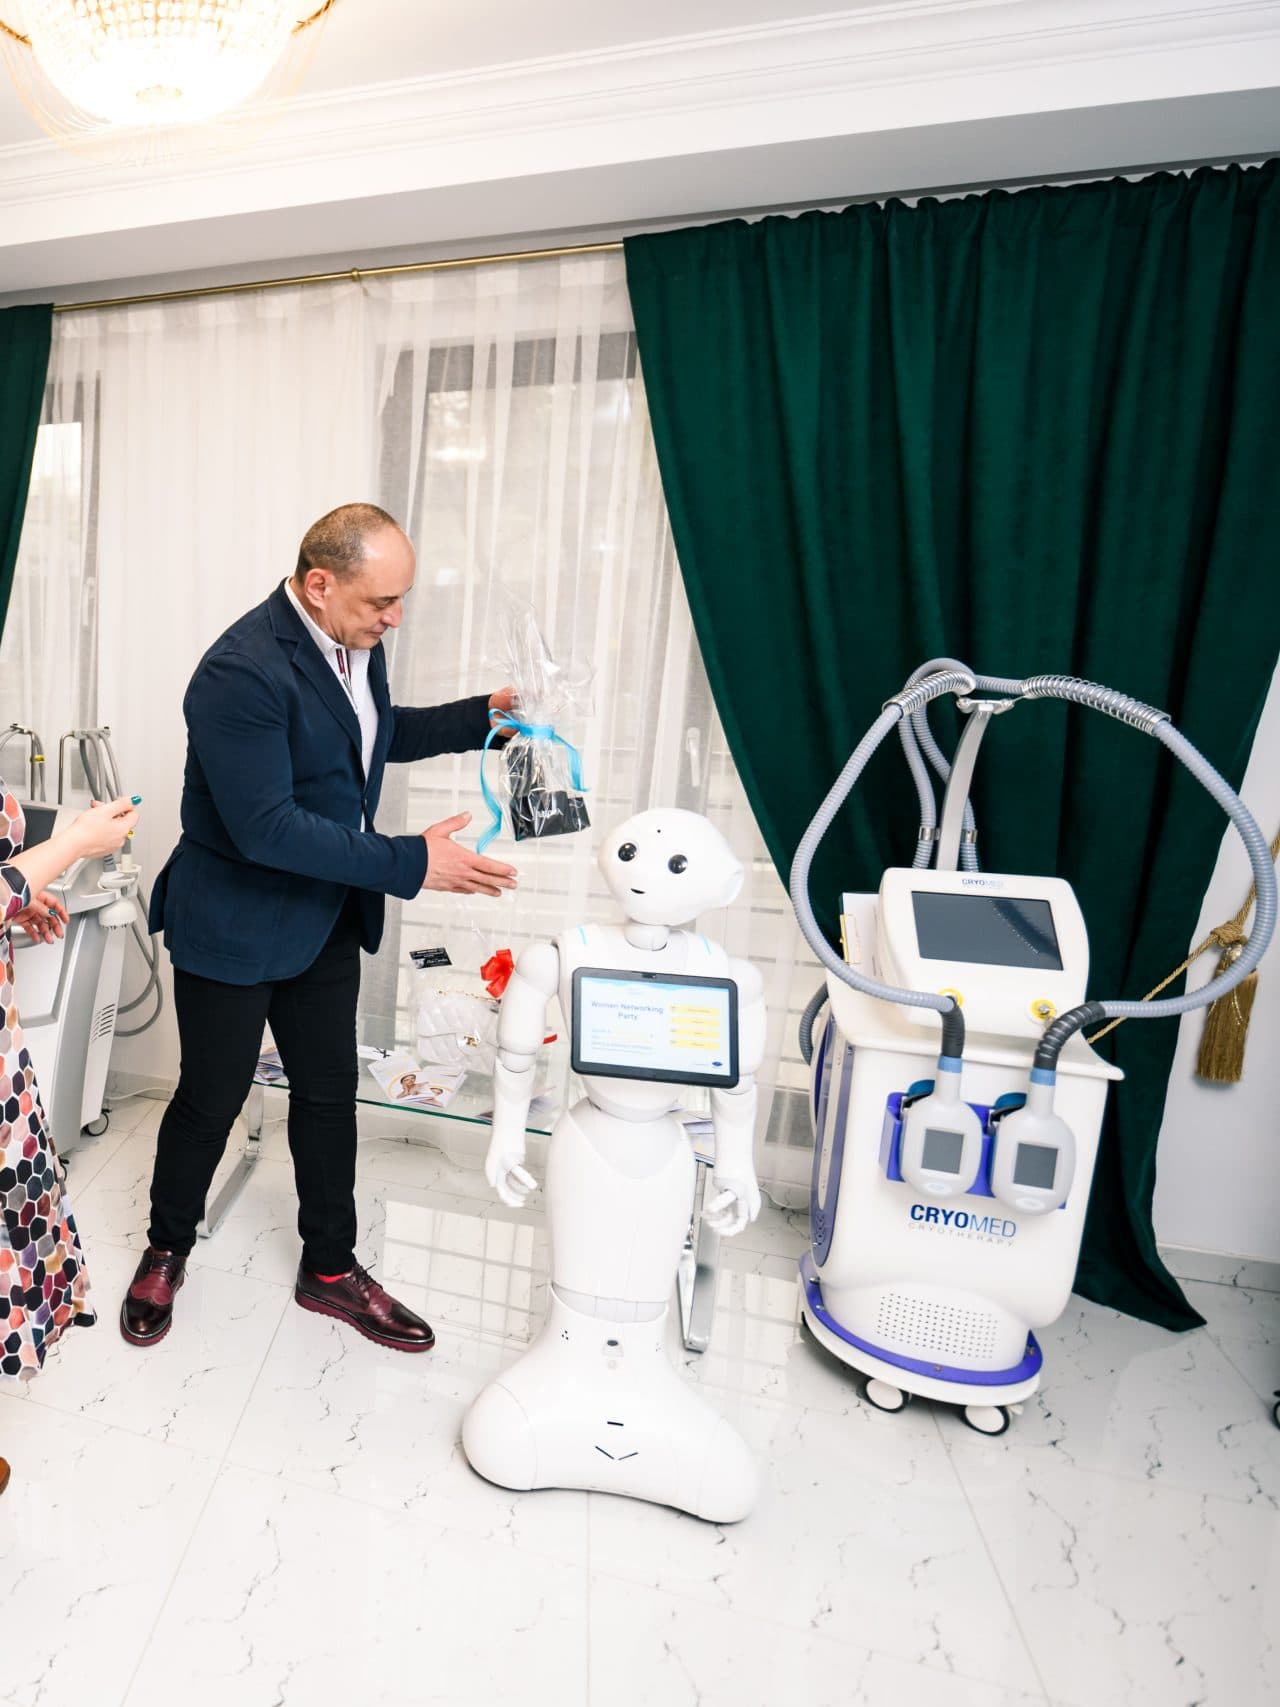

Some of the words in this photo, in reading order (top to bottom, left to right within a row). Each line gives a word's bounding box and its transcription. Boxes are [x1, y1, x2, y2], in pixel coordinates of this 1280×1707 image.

[591, 1001, 619, 1009] Women
[620, 1003, 665, 1015] Networking
[618, 1011, 638, 1021] Party
[910, 1204, 1017, 1238] CRYOMED
